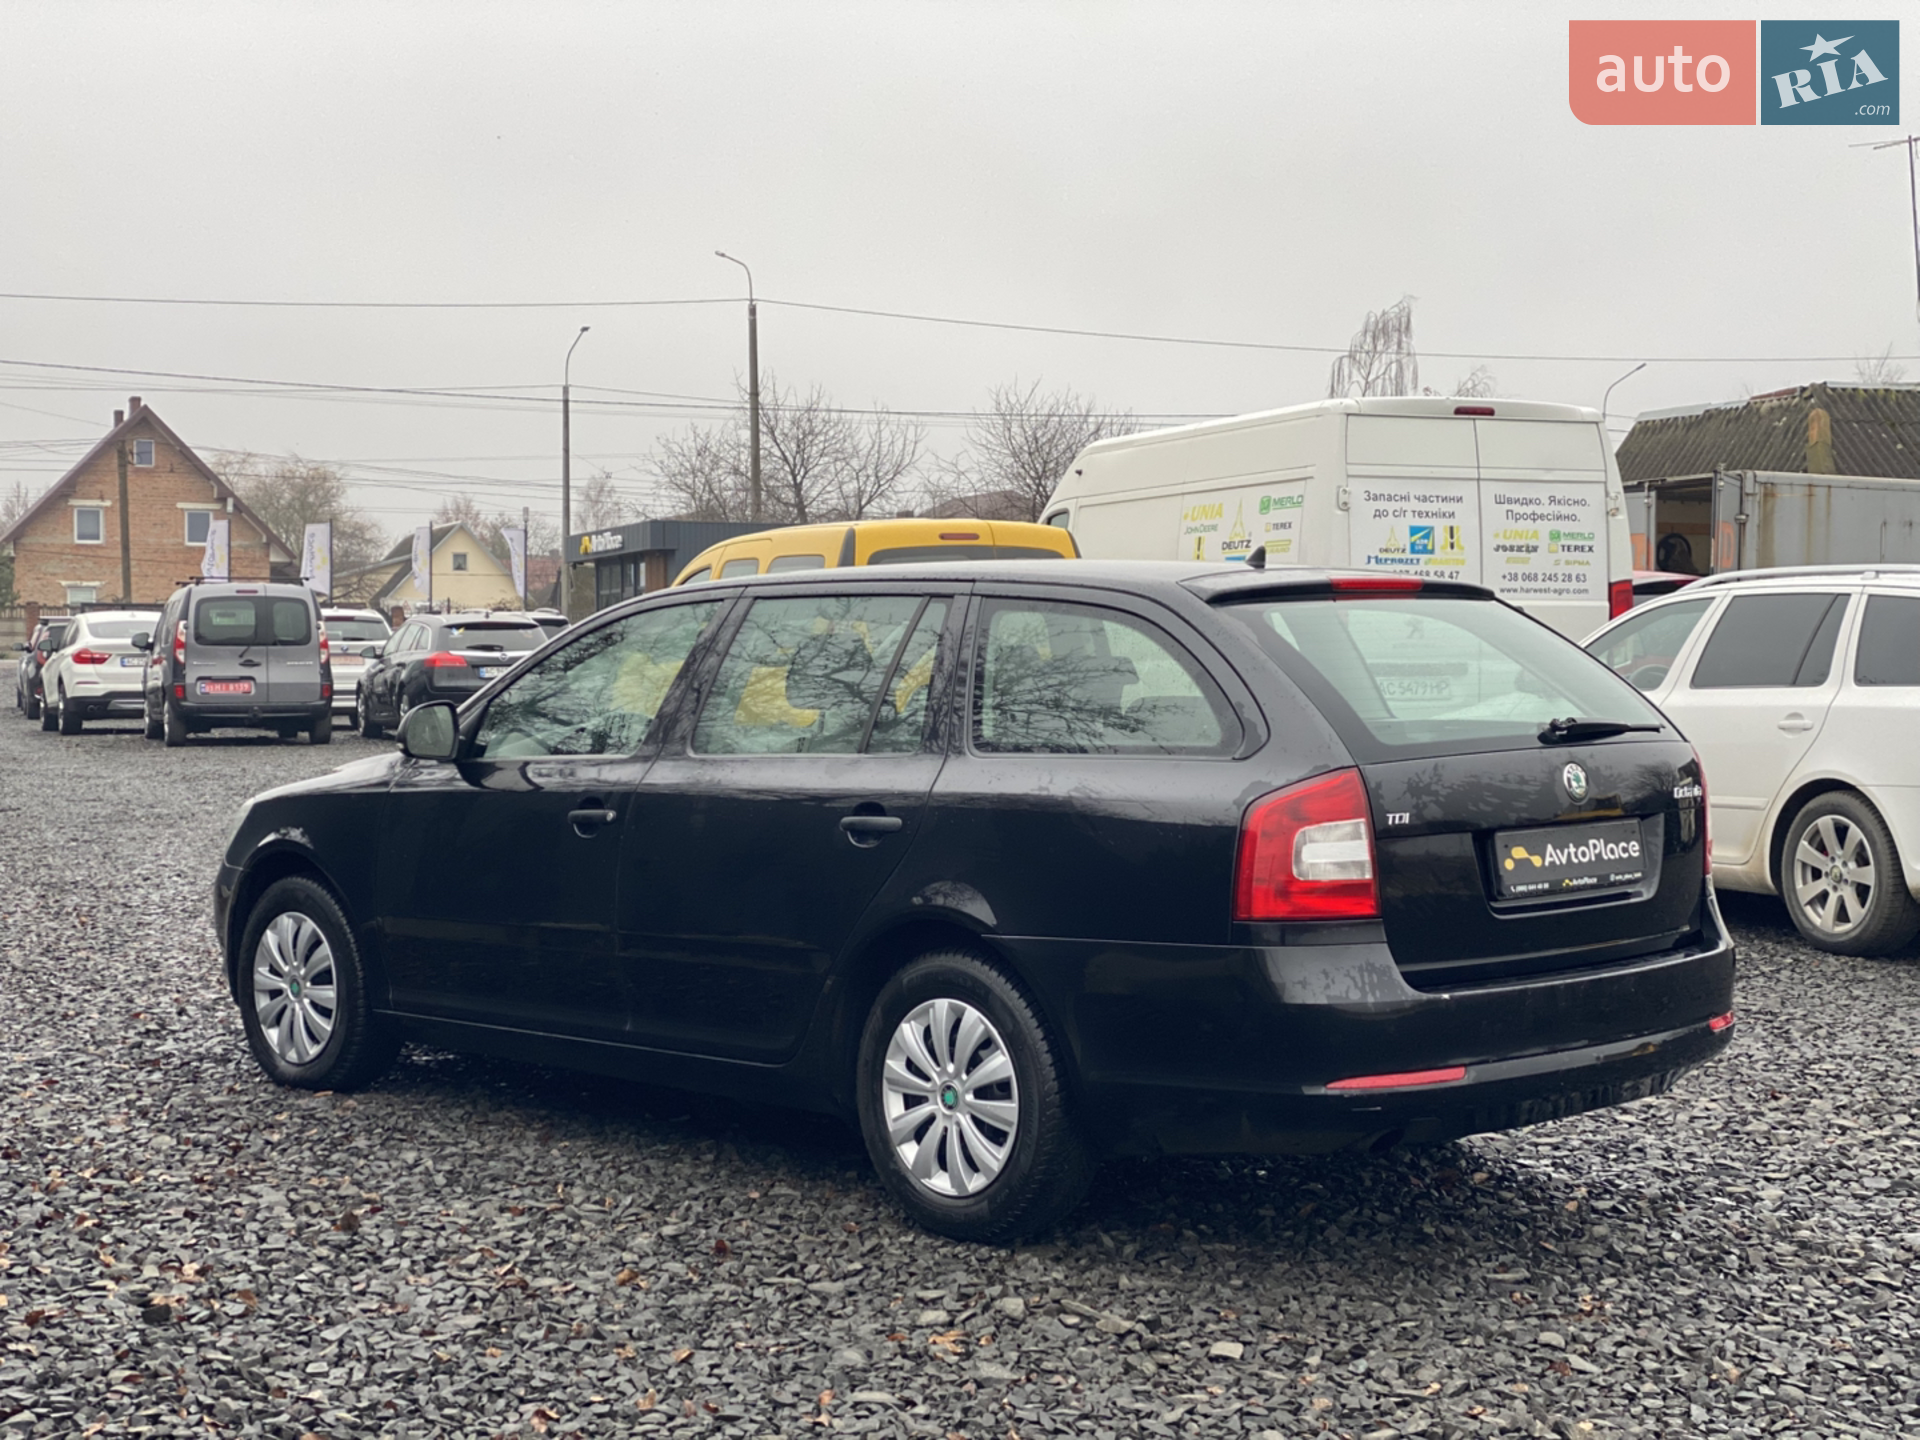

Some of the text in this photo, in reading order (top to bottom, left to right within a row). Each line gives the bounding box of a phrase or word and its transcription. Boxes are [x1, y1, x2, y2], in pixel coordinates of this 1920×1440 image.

[1273, 495, 1303, 507] MERLO
[1363, 490, 1464, 504] Запасні частини
[1494, 493, 1590, 507] Швидко. Якісно.
[1191, 503, 1223, 521] UNIA
[1373, 507, 1456, 519] до с/г техніки
[1506, 509, 1581, 523] Професійно.
[1273, 522, 1292, 530] TEREX
[1502, 529, 1540, 541] UNIA
[1563, 532, 1595, 540] MERLO
[1222, 540, 1251, 550] DEUTZ
[1493, 543, 1540, 554] JOSKIN
[1560, 544, 1595, 553] TEREX
[1447, 571, 1460, 580] 47
[1501, 572, 1587, 583] +38 068 245 28 63
[1499, 586, 1590, 596] www.harwest-agro.com
[1386, 812, 1410, 825] TDI
[1544, 838, 1640, 867] AvtoPlace
